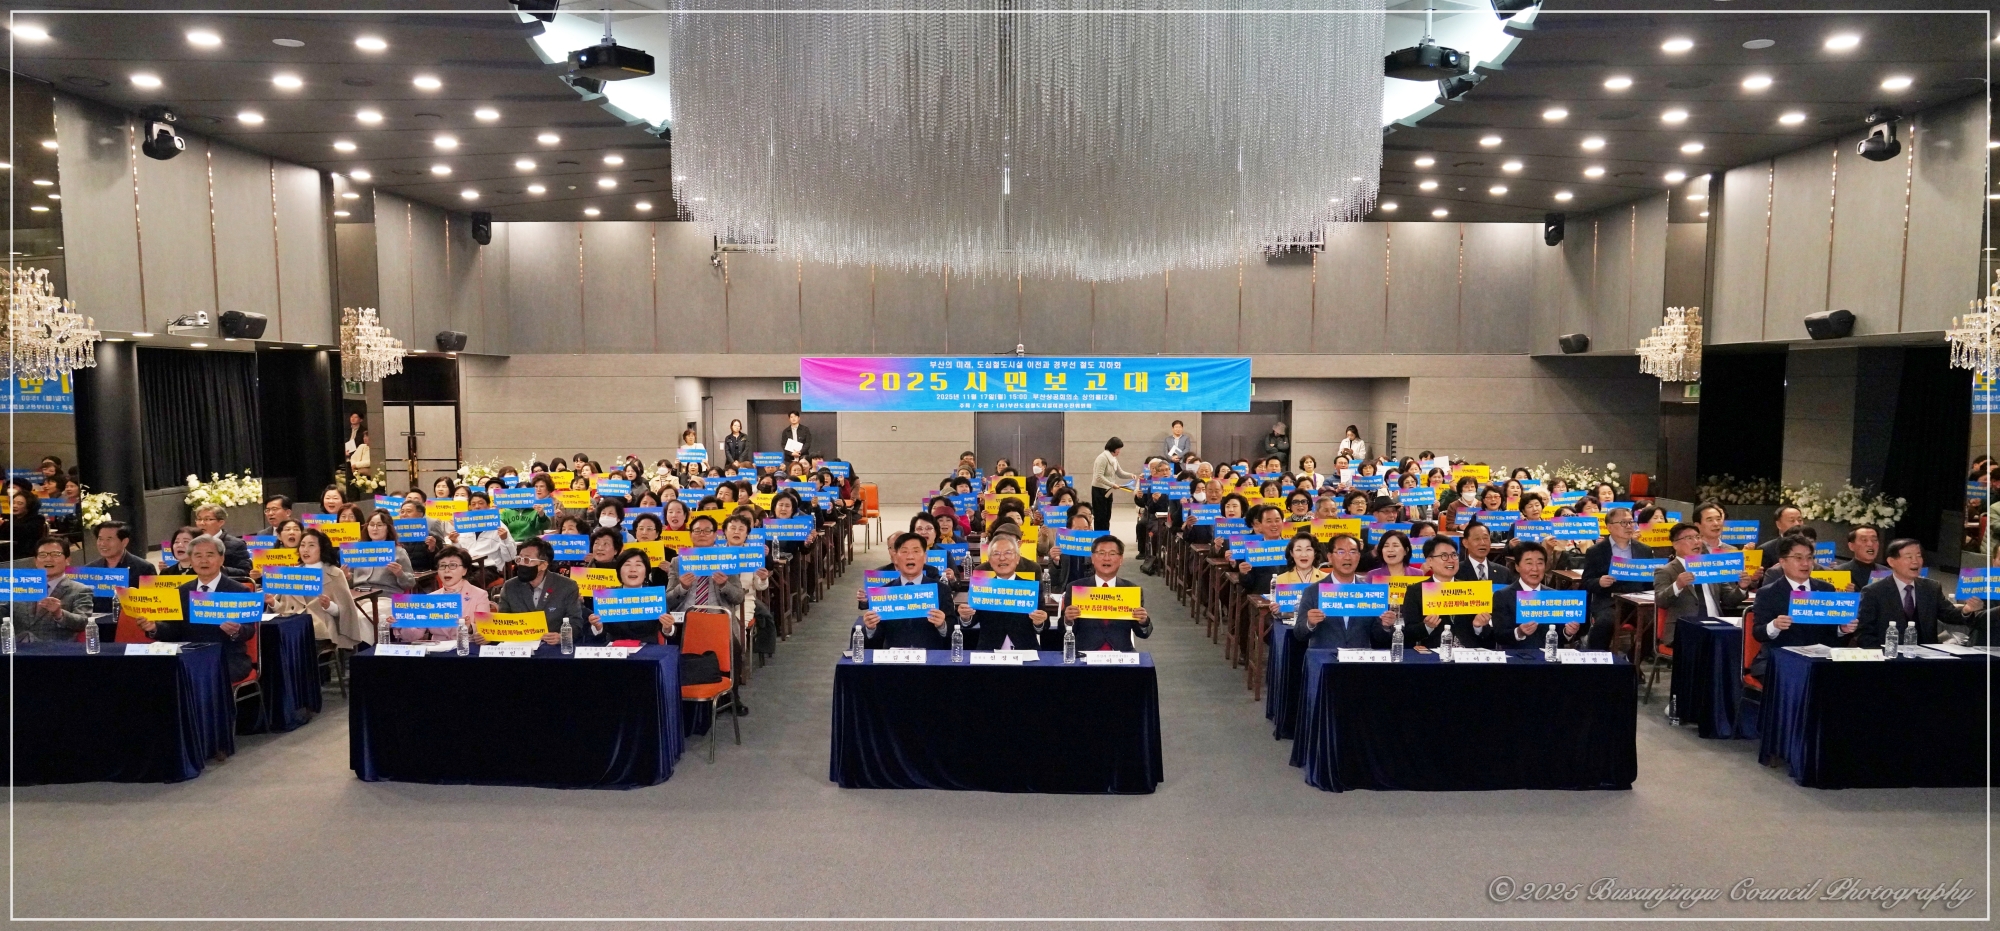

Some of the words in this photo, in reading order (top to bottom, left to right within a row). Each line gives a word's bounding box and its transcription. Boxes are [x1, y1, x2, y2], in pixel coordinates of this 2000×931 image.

[930, 361, 952, 369] 부산의
[977, 361, 1023, 369] 도심철도시설
[1027, 361, 1050, 369] 이전과
[1054, 361, 1076, 369] 경부선
[1080, 361, 1095, 369] 철도
[1098, 361, 1122, 369] 지하화
[858, 372, 948, 391] 2025
